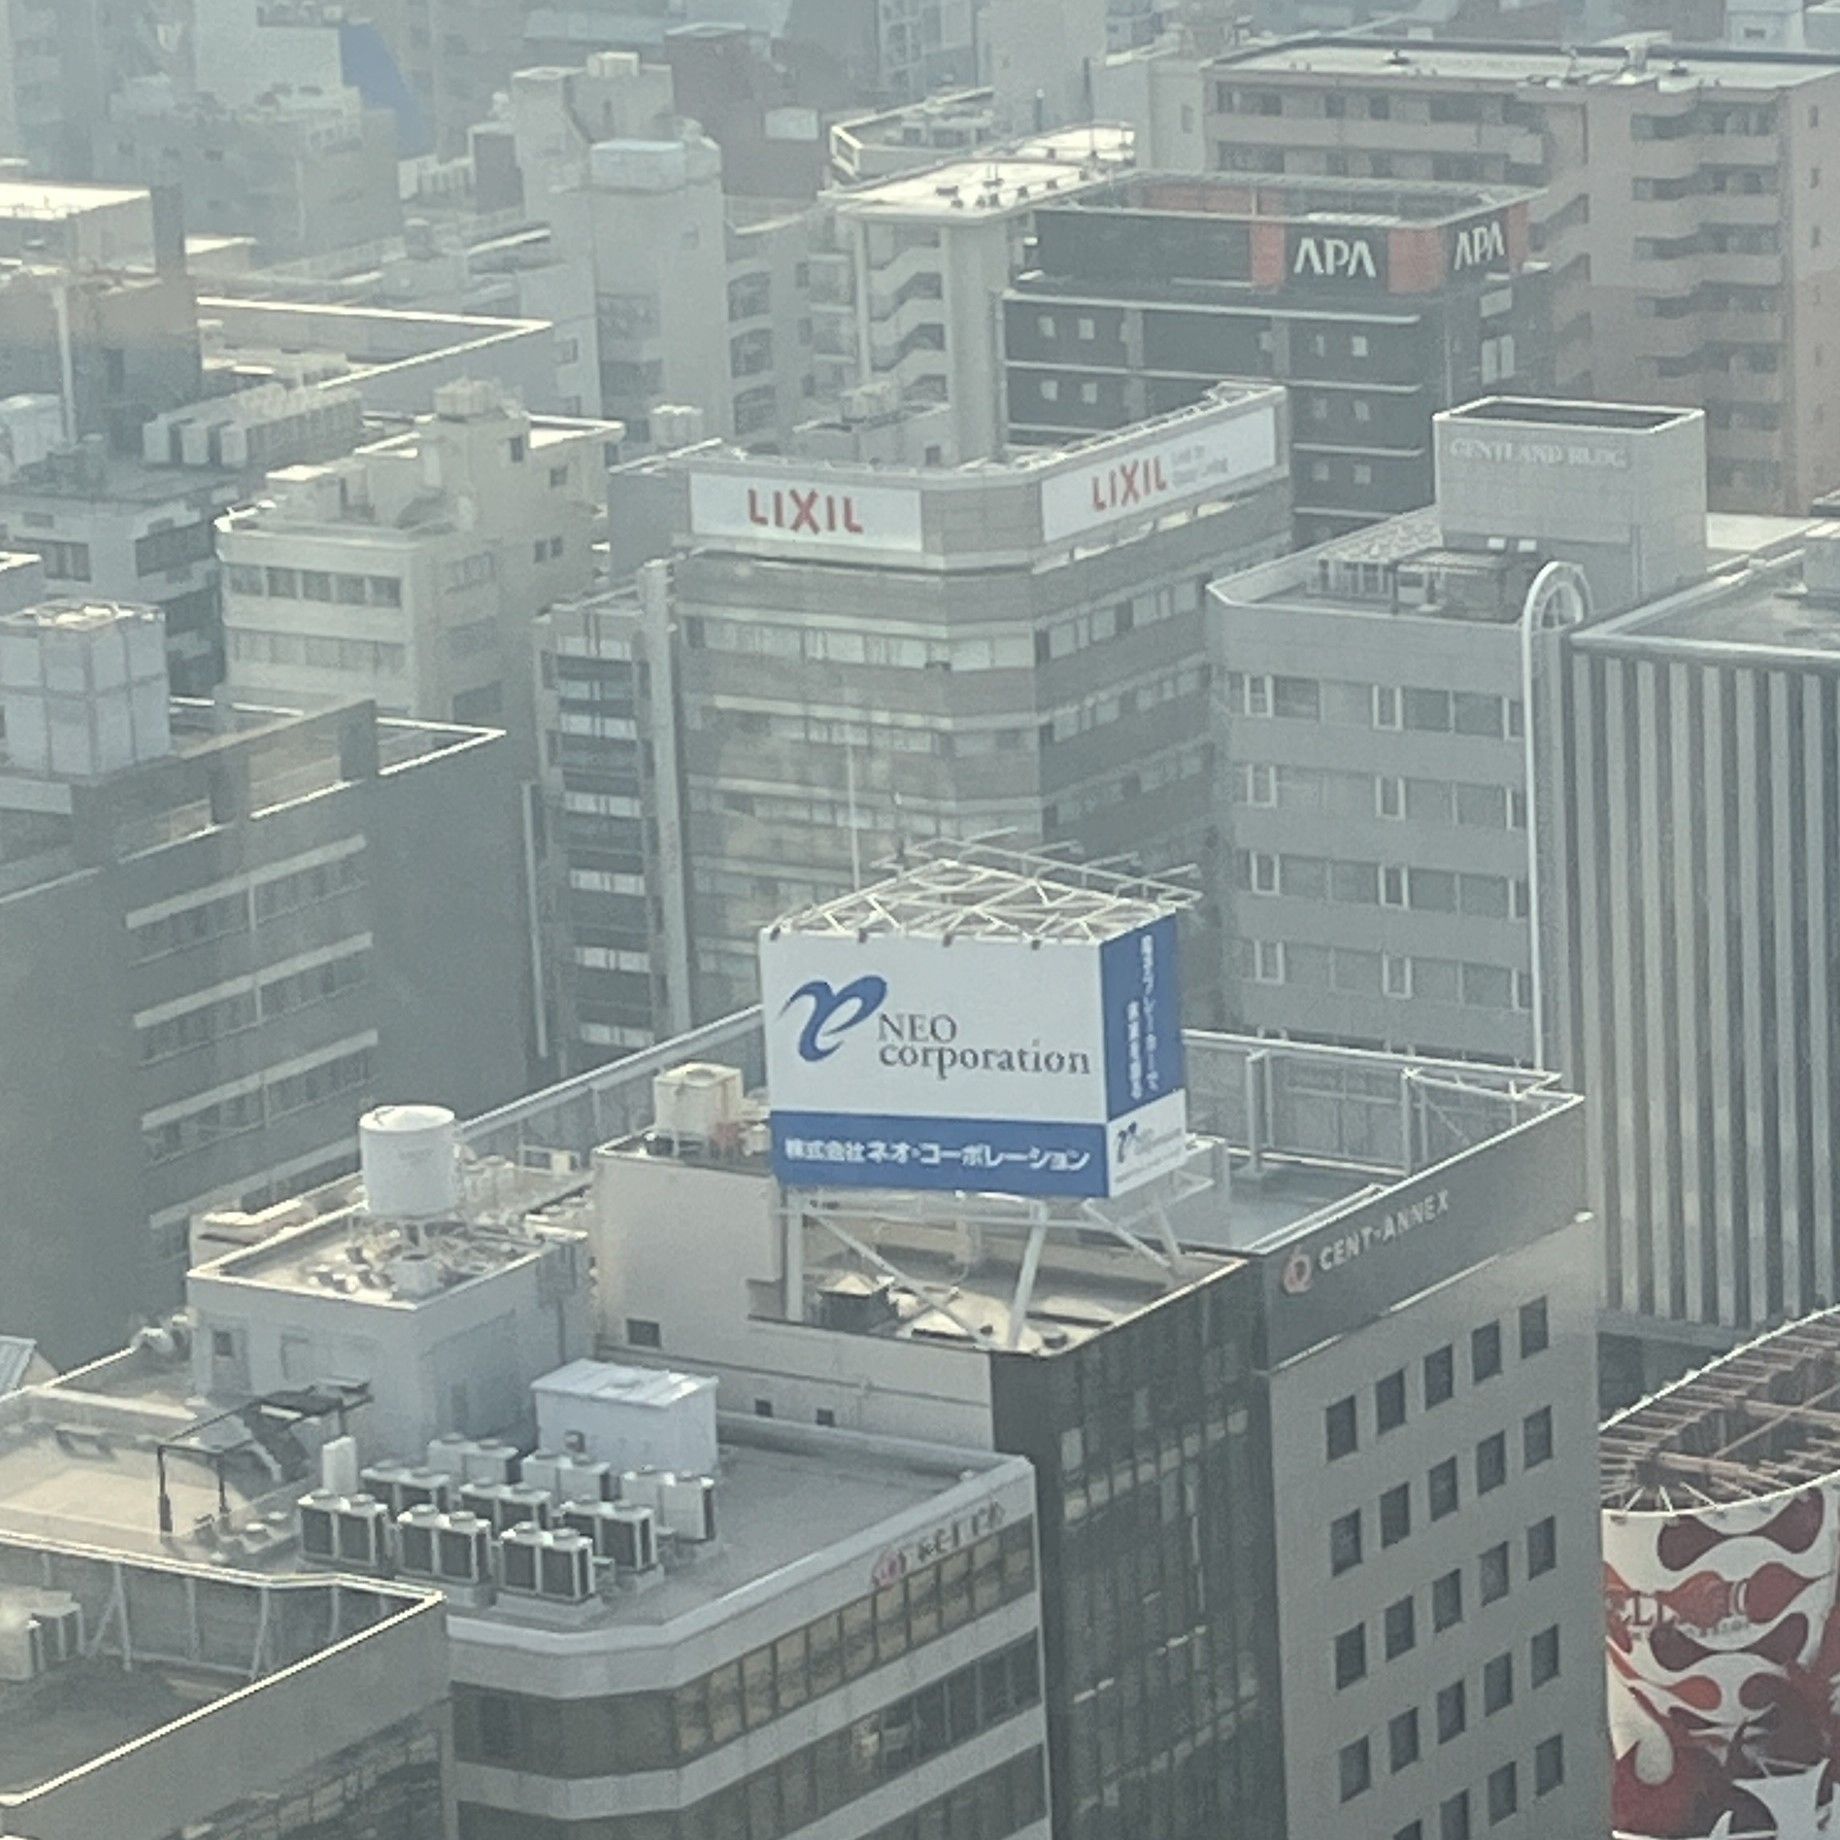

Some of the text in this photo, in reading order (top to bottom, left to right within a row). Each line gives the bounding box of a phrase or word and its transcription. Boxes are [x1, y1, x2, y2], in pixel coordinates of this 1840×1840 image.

[1294, 238, 1376, 278] APA
[1454, 221, 1504, 270] APA
[1091, 456, 1167, 511] LIXIL
[748, 489, 864, 534] LIXIL
[879, 1013, 957, 1043] NEO
[879, 1039, 1090, 1079] corporation
